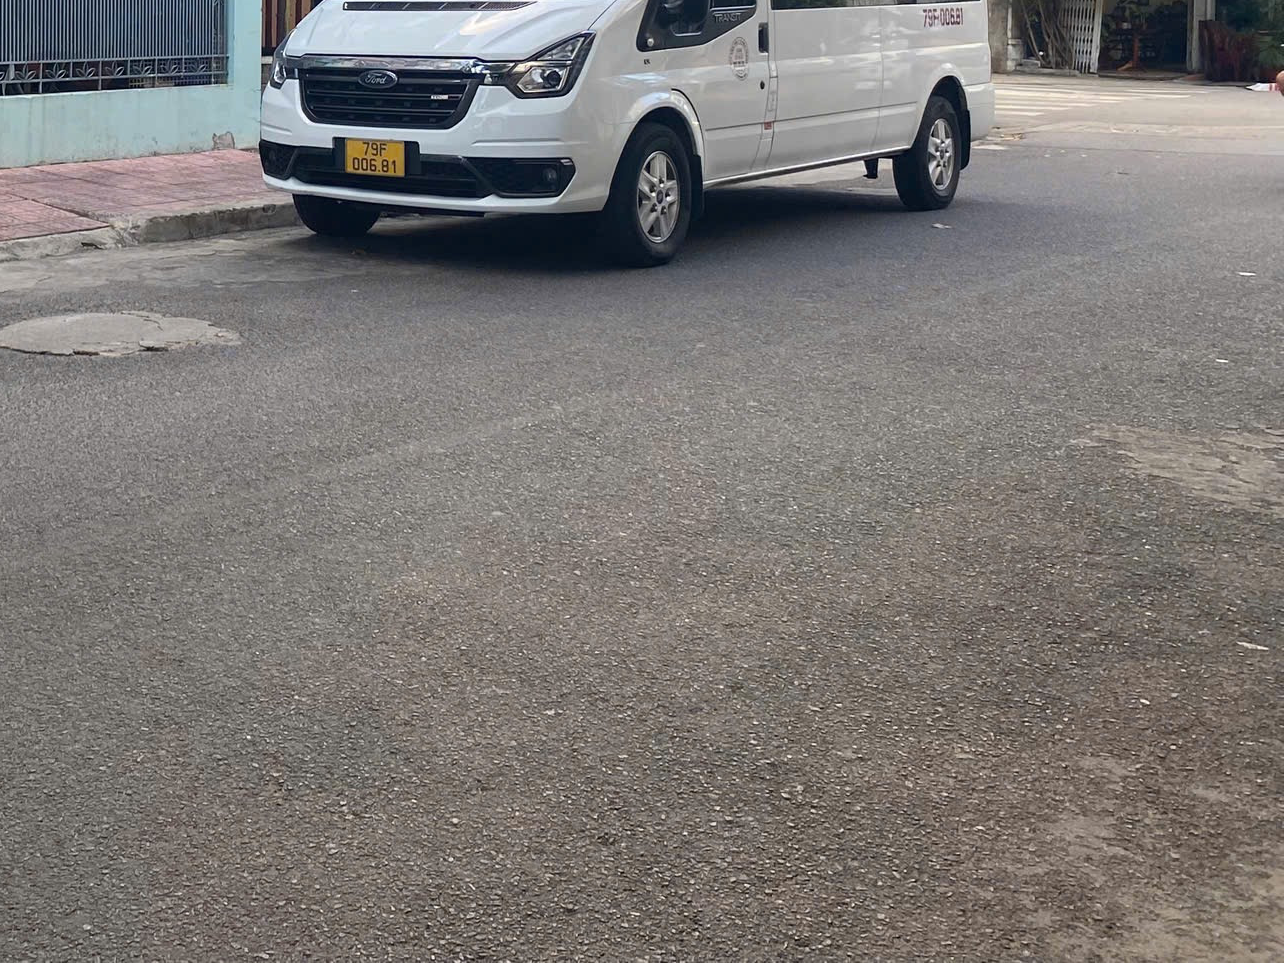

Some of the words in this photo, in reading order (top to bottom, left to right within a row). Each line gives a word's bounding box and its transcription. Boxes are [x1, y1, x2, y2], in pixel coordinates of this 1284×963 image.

[714, 12, 742, 22] TRANSIT
[365, 73, 388, 84] Ford
[362, 141, 388, 157] 79F
[352, 157, 397, 174] 006.81
